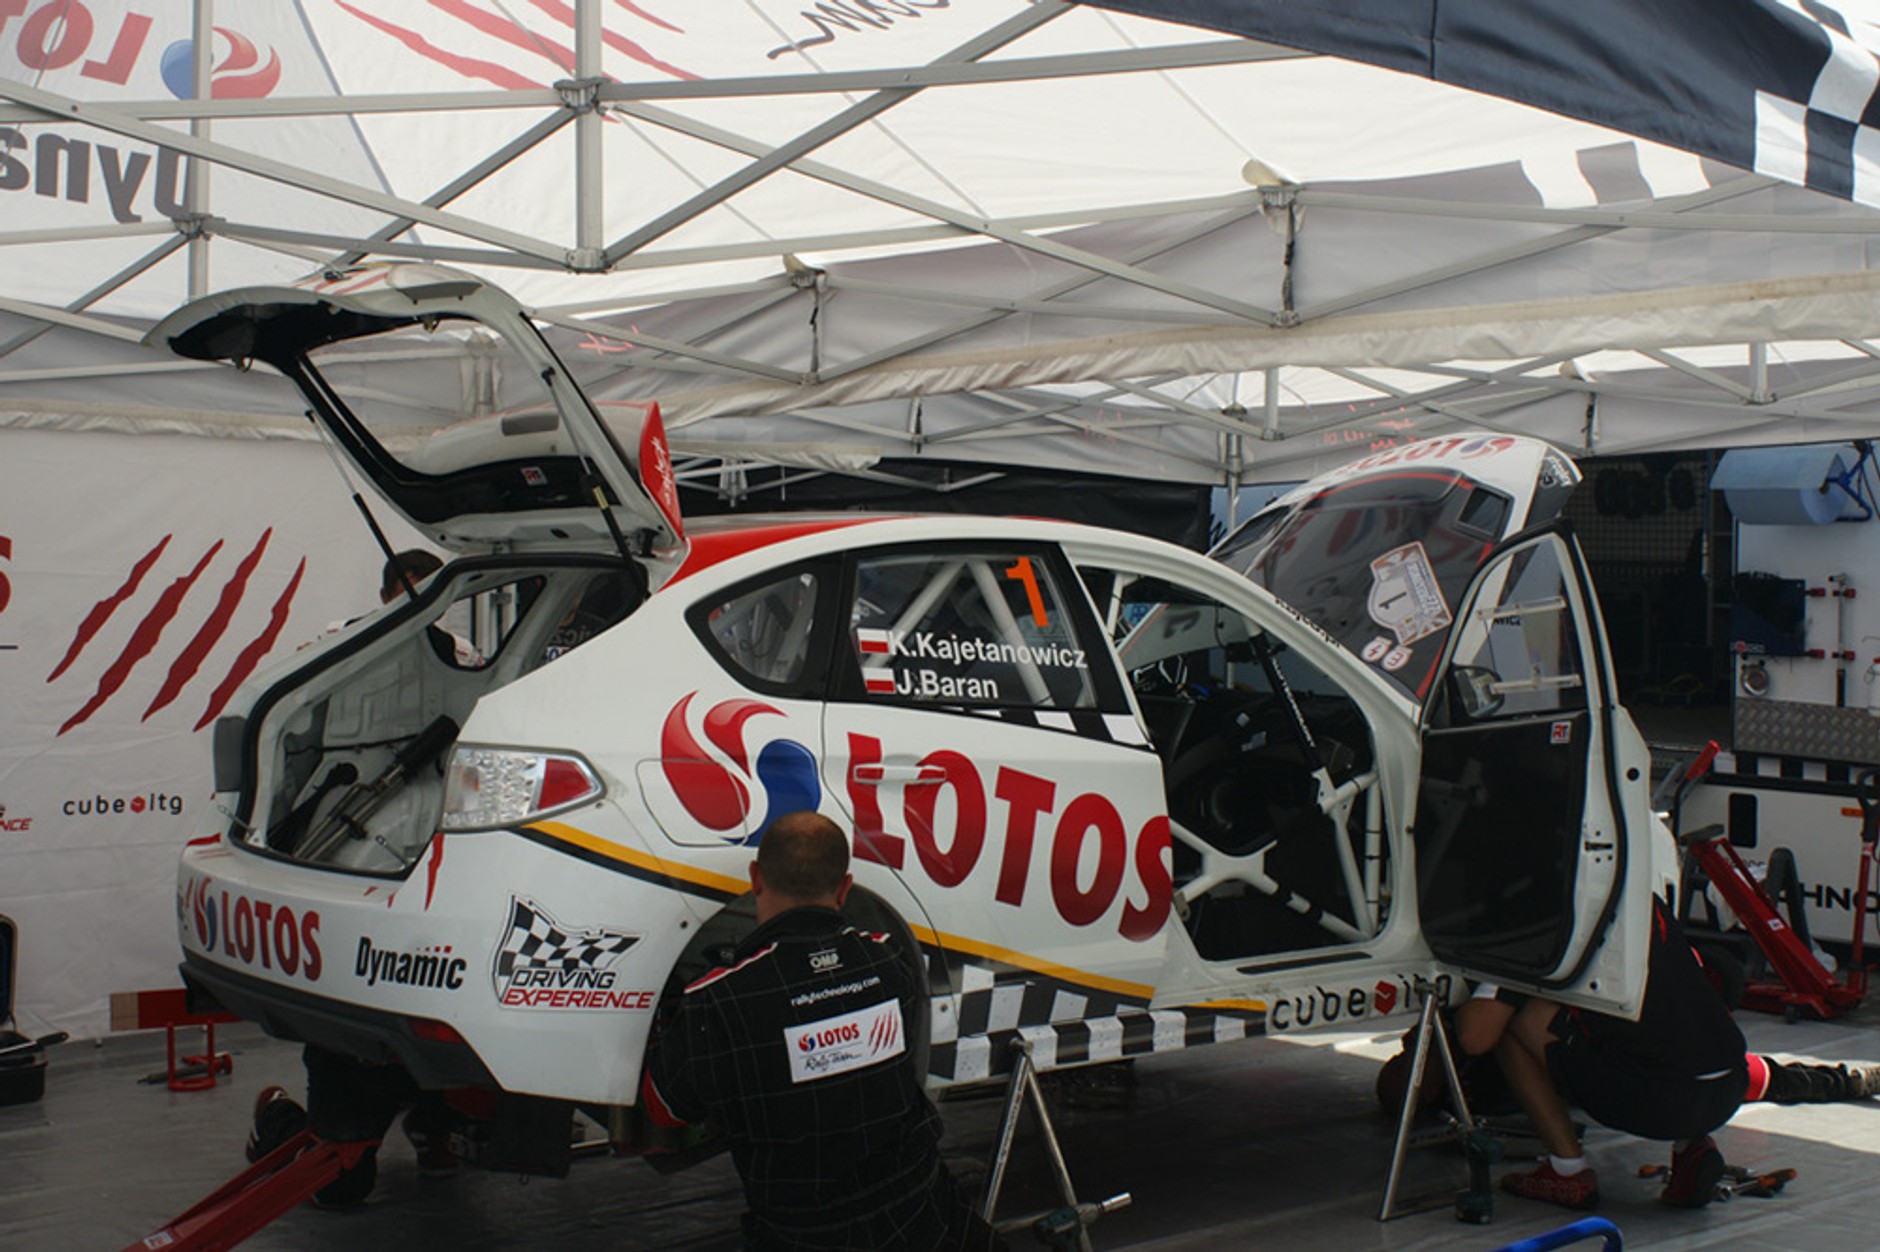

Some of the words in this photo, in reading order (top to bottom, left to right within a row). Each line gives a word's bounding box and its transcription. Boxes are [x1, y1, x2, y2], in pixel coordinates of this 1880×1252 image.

[1005, 556, 1049, 627] 1
[889, 630, 1087, 668] K.Kajetanowicz
[896, 669, 999, 699] J.Baran
[62, 794, 126, 816] cube
[847, 731, 1173, 943] LOTOS
[222, 890, 322, 982] LOTOS
[355, 936, 467, 990] Dynamic
[511, 969, 617, 989] DRIVING
[501, 989, 656, 1009] EXPERIENCE
[1271, 985, 1367, 1030] cube
[816, 1022, 860, 1049] LOTOS
